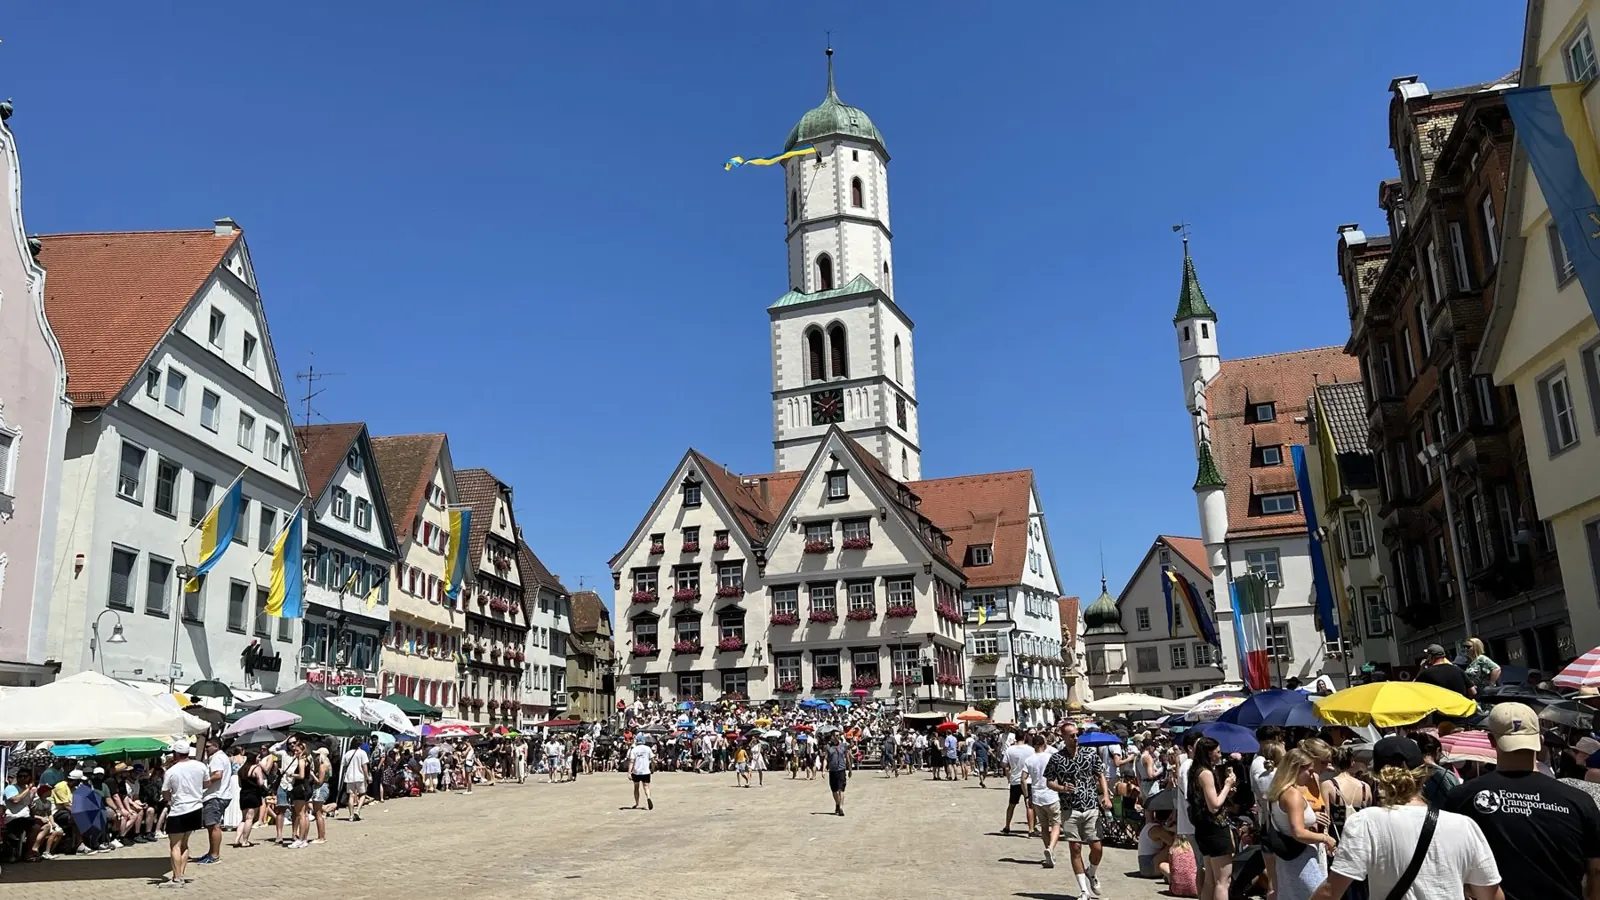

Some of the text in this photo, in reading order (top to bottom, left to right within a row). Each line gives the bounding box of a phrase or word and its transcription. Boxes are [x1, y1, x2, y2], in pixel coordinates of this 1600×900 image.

[1499, 789, 1540, 801] Forward
[1501, 804, 1532, 817] Group
[1502, 797, 1570, 814] Transportation
